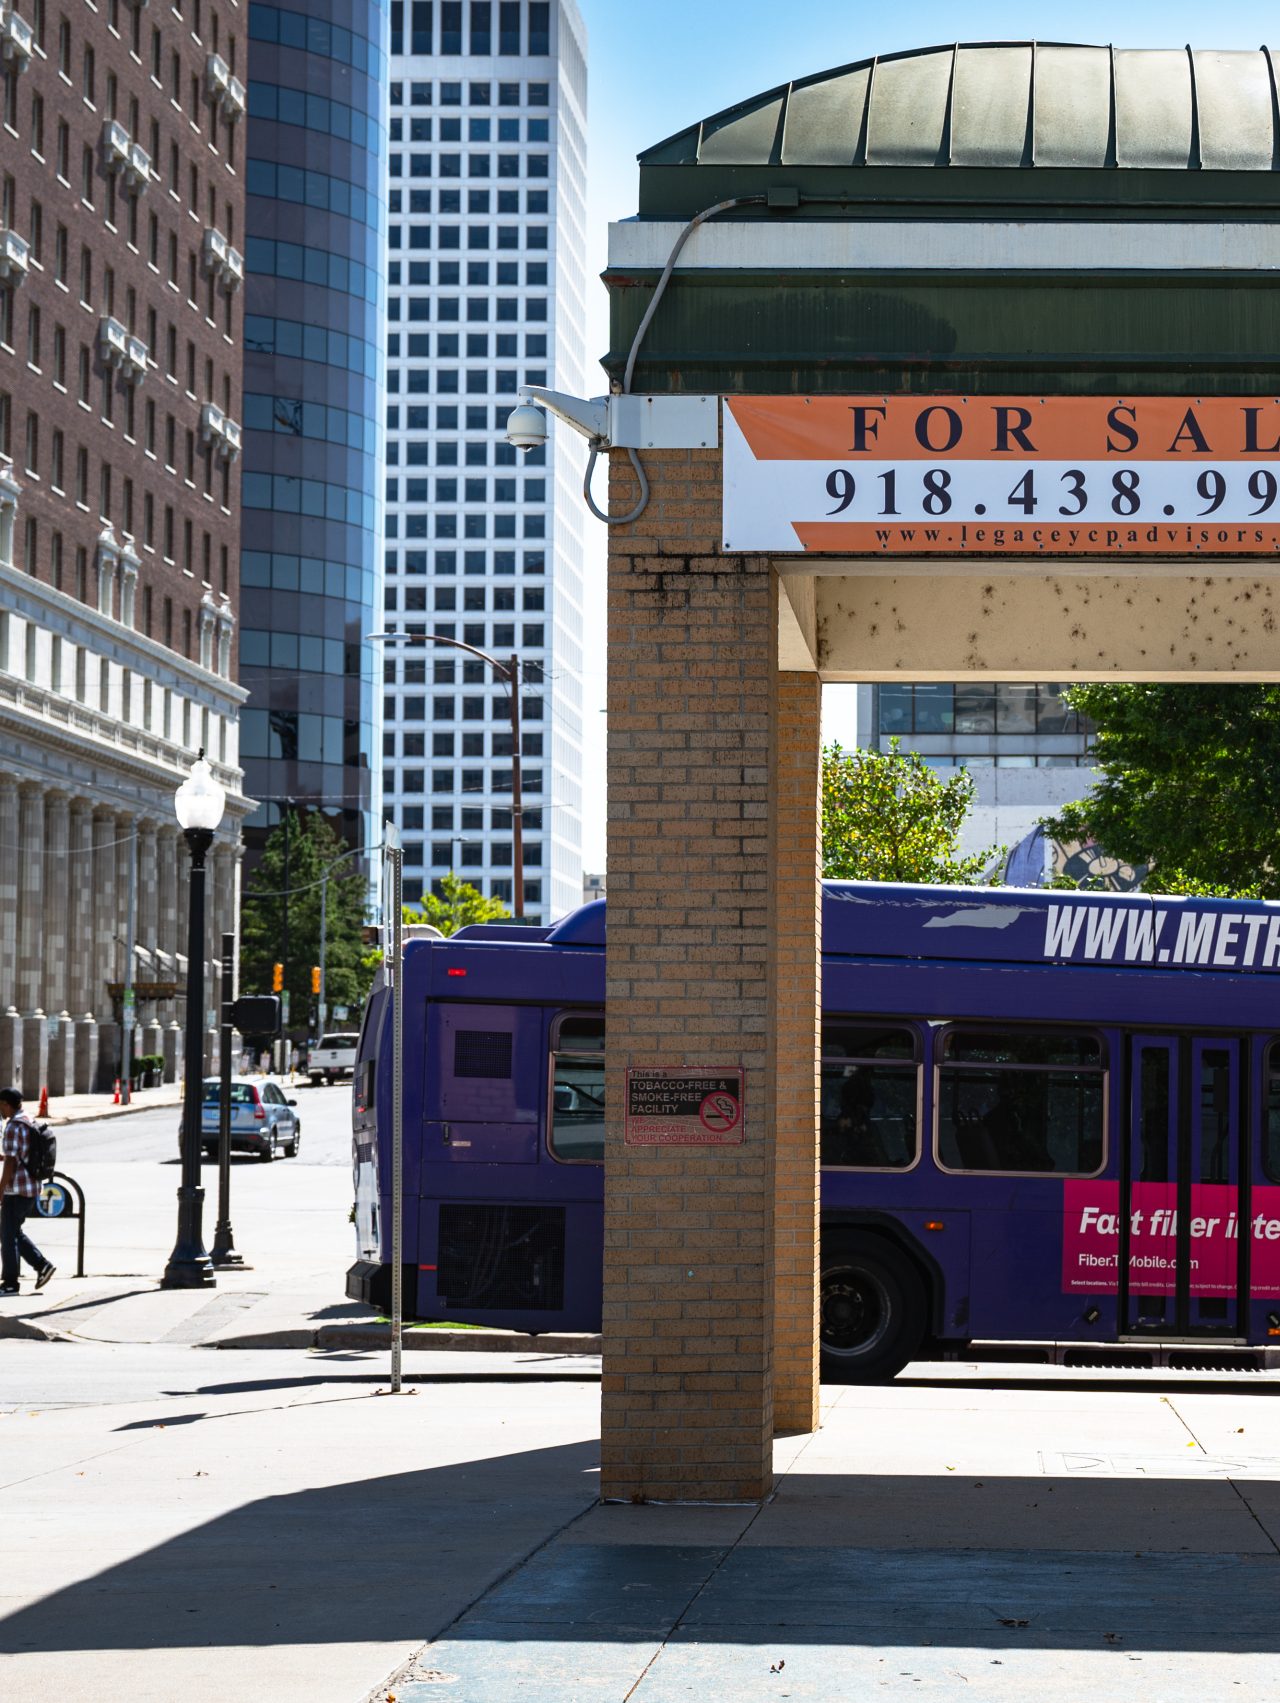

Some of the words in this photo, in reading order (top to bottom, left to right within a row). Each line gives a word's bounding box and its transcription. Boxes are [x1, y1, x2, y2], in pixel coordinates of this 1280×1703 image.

[847, 405, 1039, 453] FOR
[631, 1070, 650, 1078] This
[652, 1070, 659, 1078] is
[631, 1081, 716, 1090] TOBACCO-FREE
[719, 1081, 727, 1090] &
[631, 1092, 702, 1102] SMOKE-FREE
[631, 1104, 679, 1114] FACILITY
[1079, 1206, 1144, 1236] Fat
